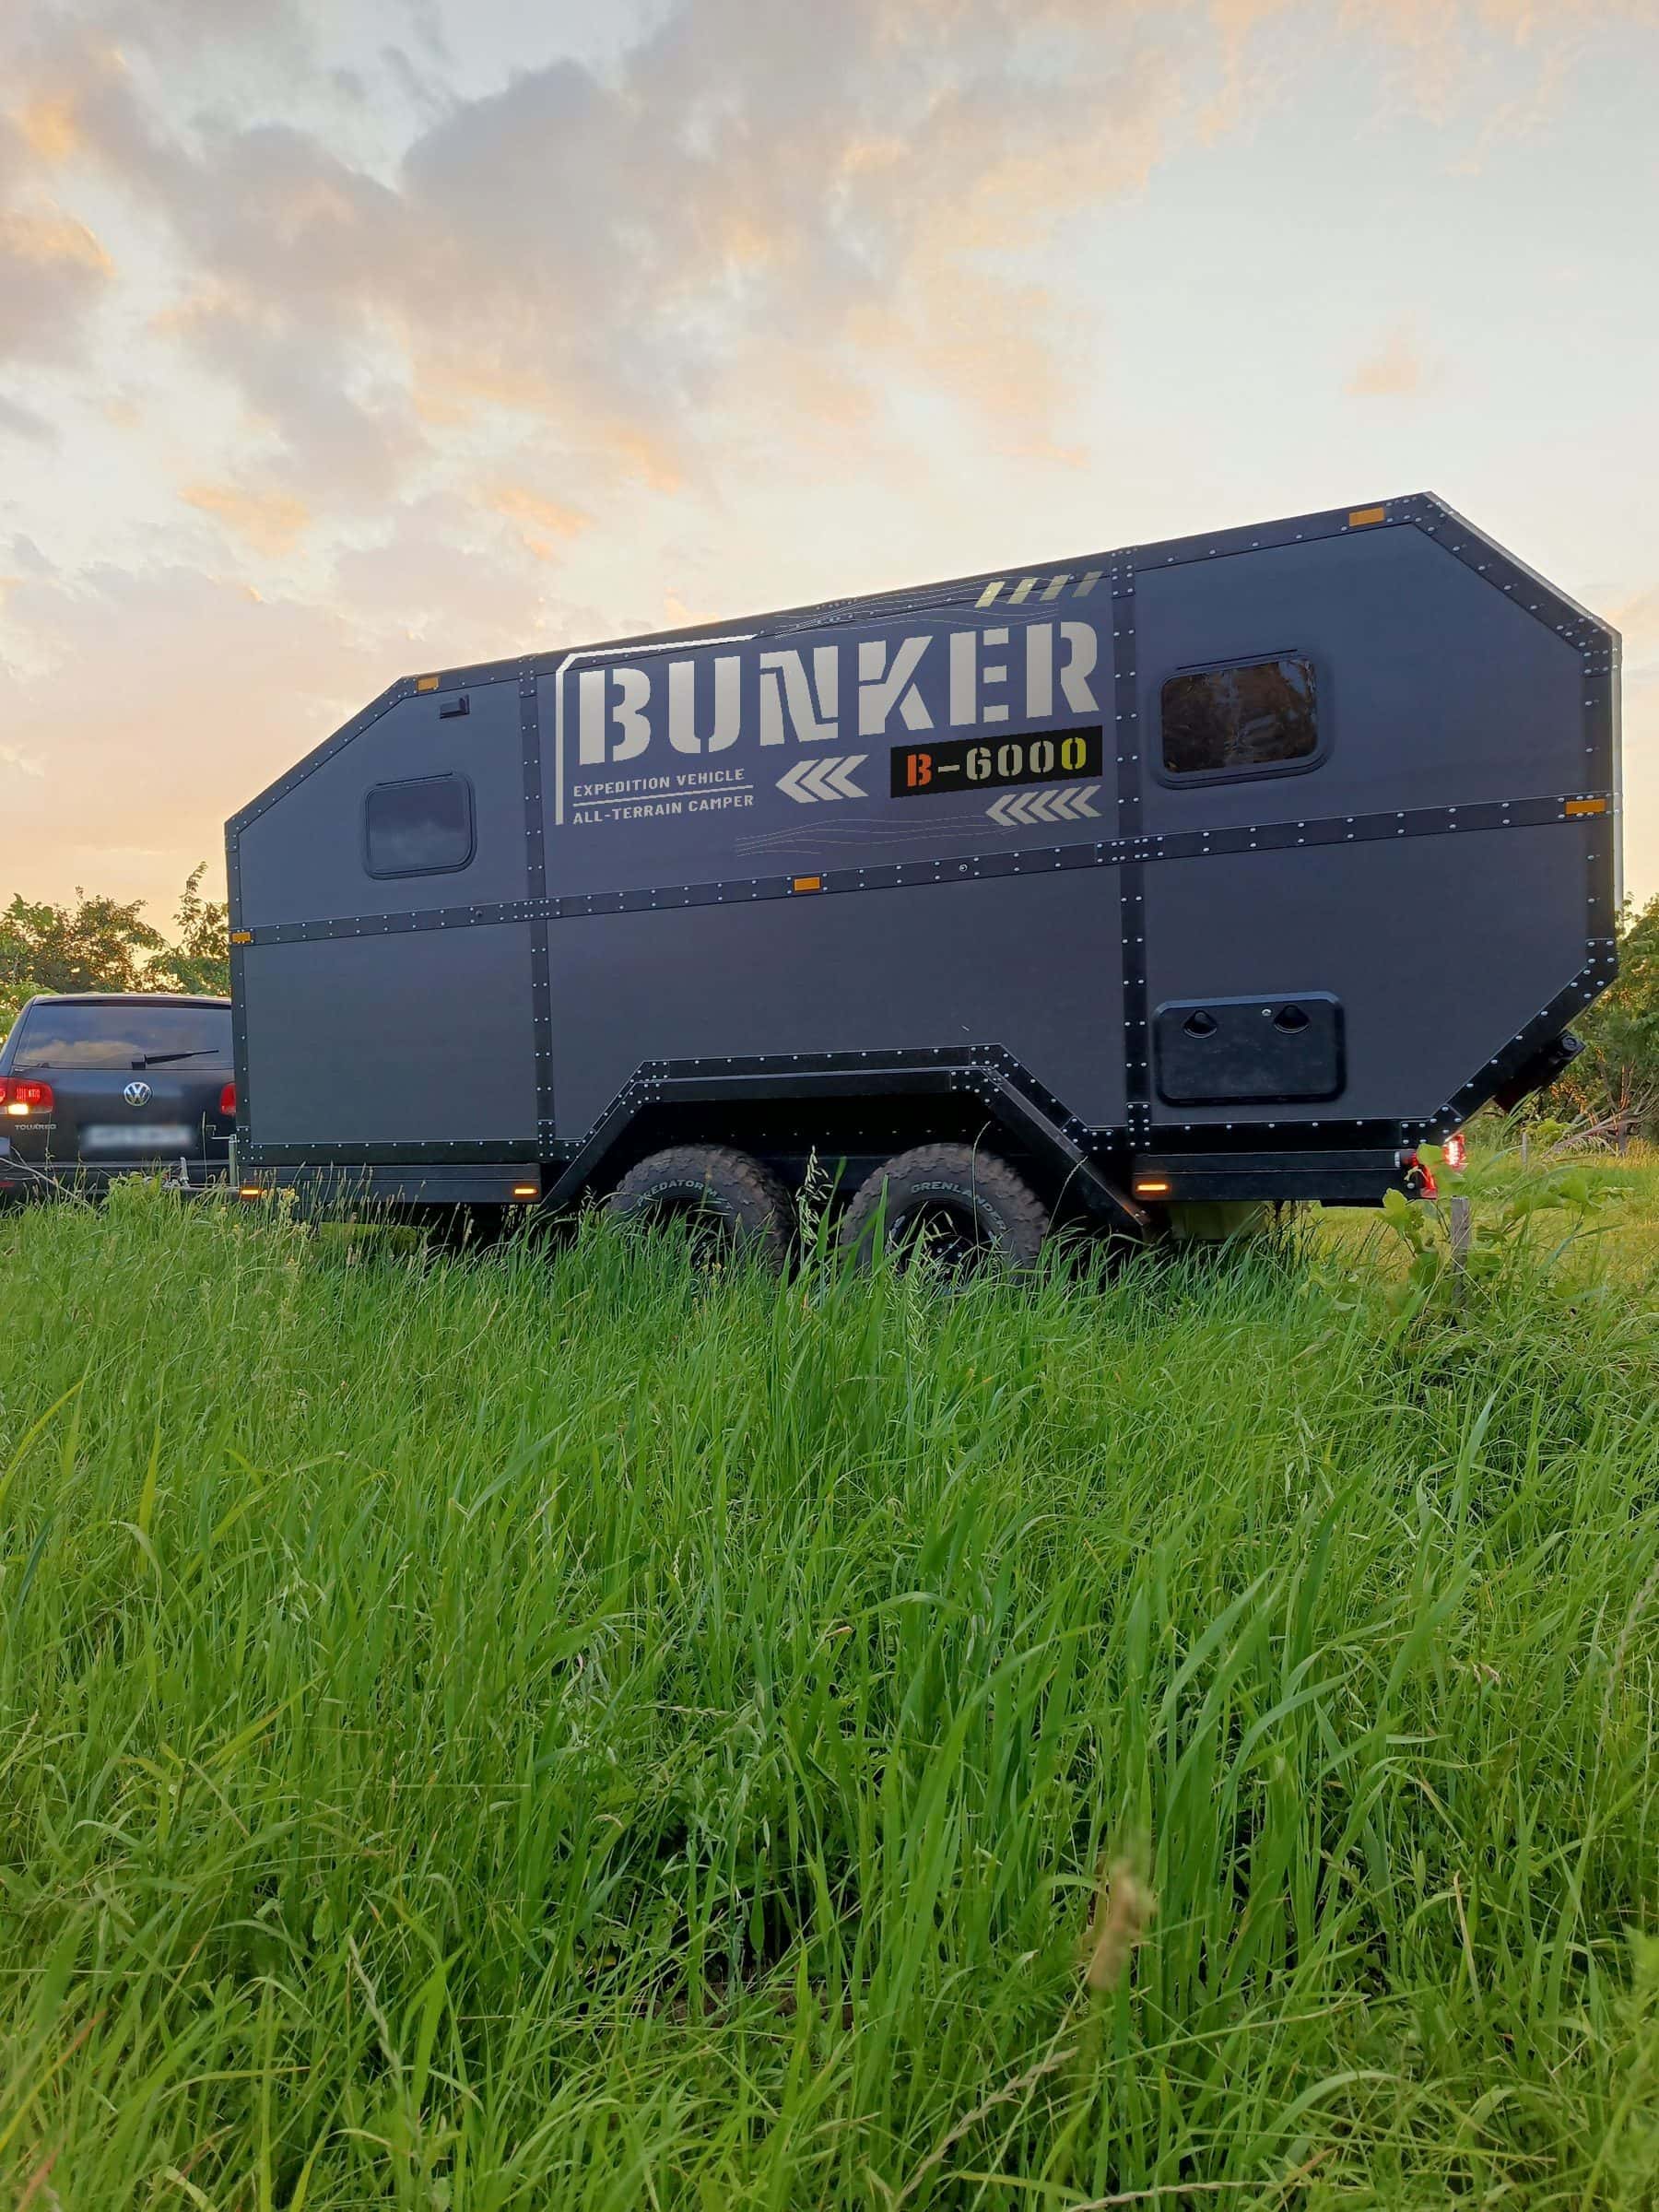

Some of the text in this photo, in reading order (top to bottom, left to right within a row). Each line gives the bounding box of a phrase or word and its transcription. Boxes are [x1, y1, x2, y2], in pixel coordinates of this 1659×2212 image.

[579, 621, 1100, 765] BUNKER
[907, 737, 1087, 787] B-6000
[573, 769, 745, 797] EXPEDITION VEHICLE
[572, 795, 754, 825] ALL-TERRAIN CAMPER
